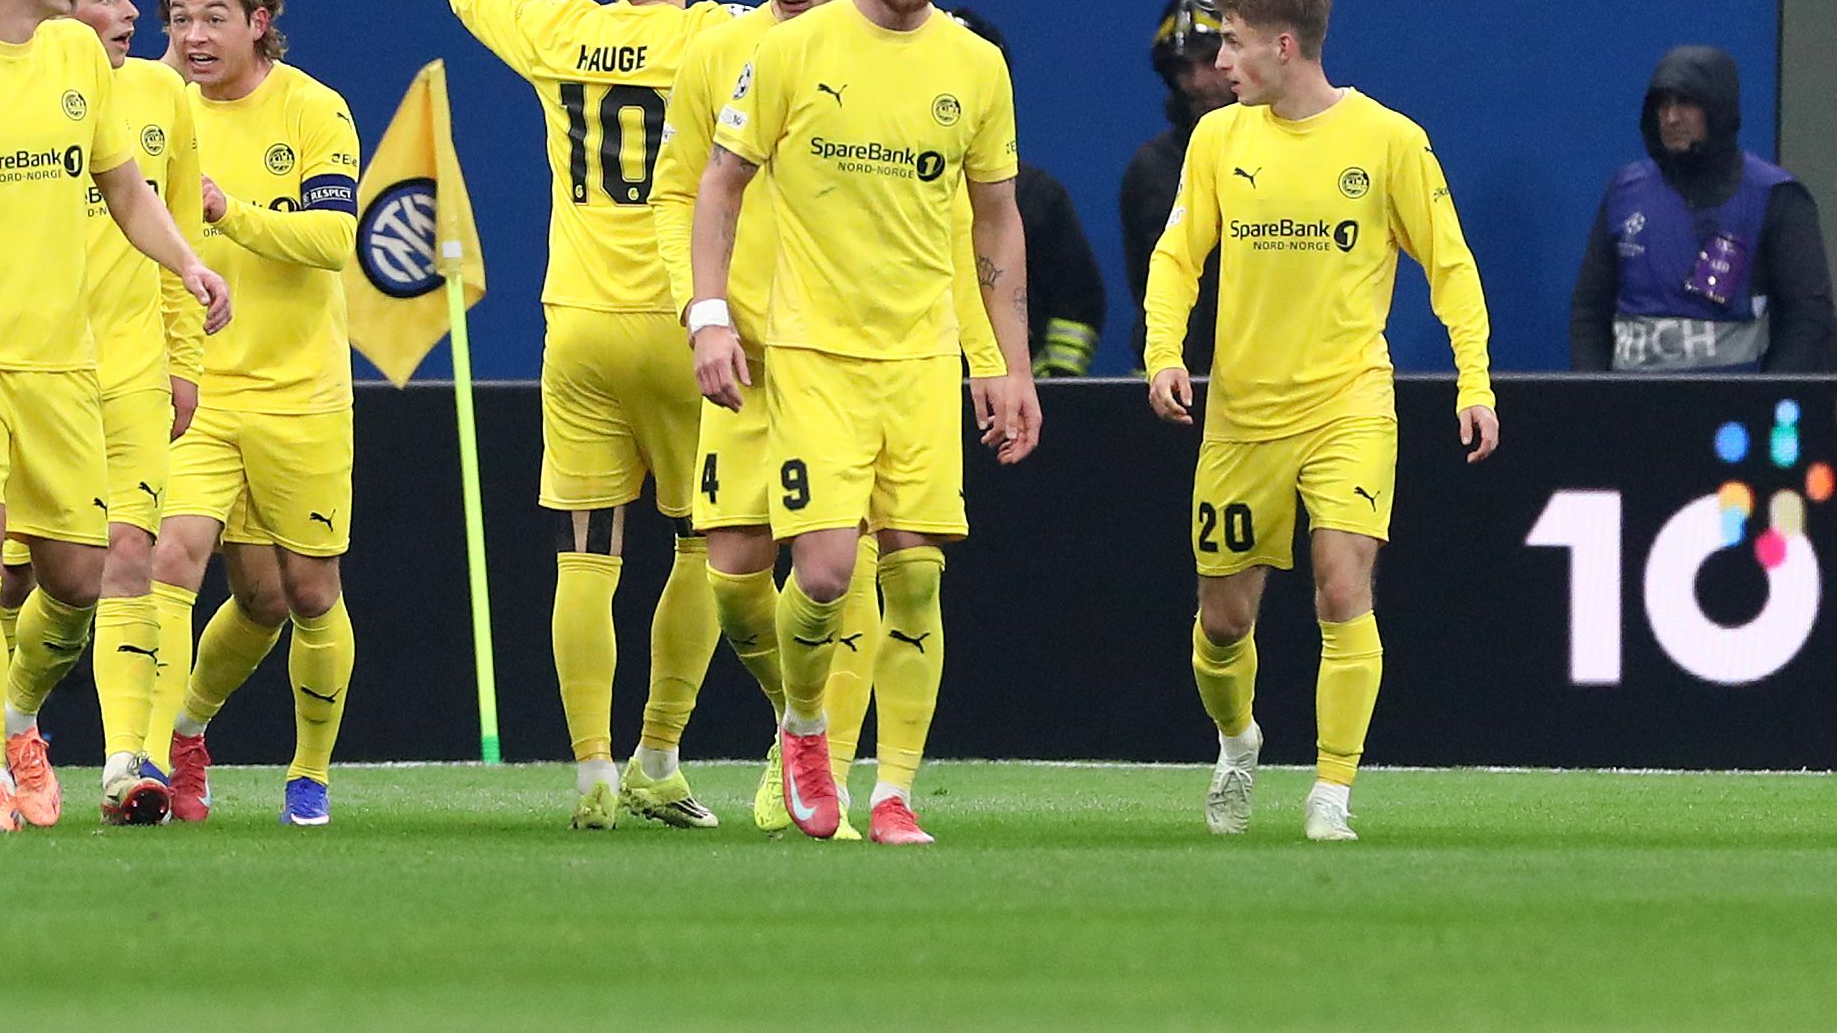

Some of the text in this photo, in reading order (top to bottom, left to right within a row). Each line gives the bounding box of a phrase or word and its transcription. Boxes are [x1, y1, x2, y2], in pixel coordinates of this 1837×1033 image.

[576, 44, 648, 72] HAUGE
[559, 82, 666, 206] 10
[811, 137, 916, 165] SpareBank
[837, 161, 914, 179] NORD-NORGE
[311, 188, 351, 200] RESPECT
[1230, 219, 1330, 240] SpareBank
[1253, 241, 1330, 251] NORD-NORGE
[701, 453, 719, 505] 4
[781, 458, 811, 511] 9
[1198, 502, 1255, 553] 20
[1524, 489, 1821, 685] 10
